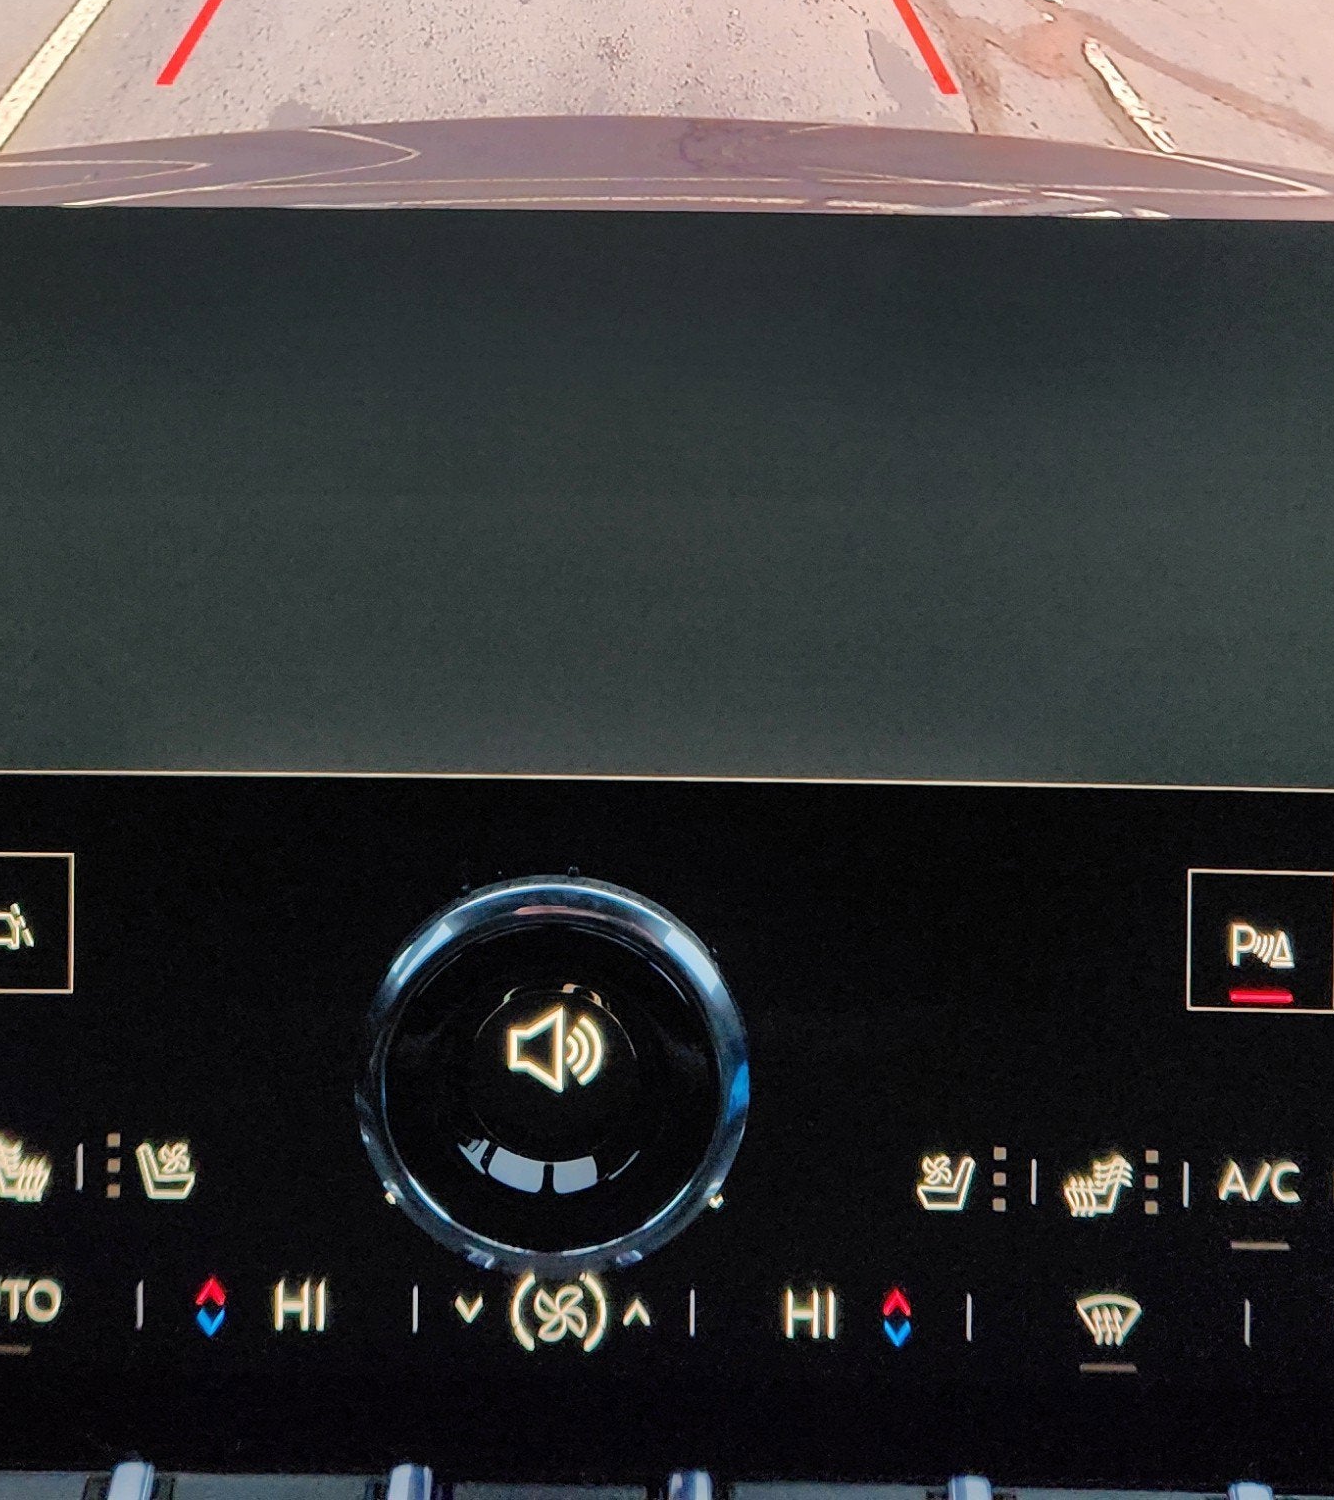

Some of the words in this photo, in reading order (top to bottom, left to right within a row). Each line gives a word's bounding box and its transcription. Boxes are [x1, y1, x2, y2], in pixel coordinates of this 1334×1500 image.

[1217, 1159, 1302, 1203] A/C
[273, 1278, 328, 1333] HI
[784, 1287, 838, 1341] HI
